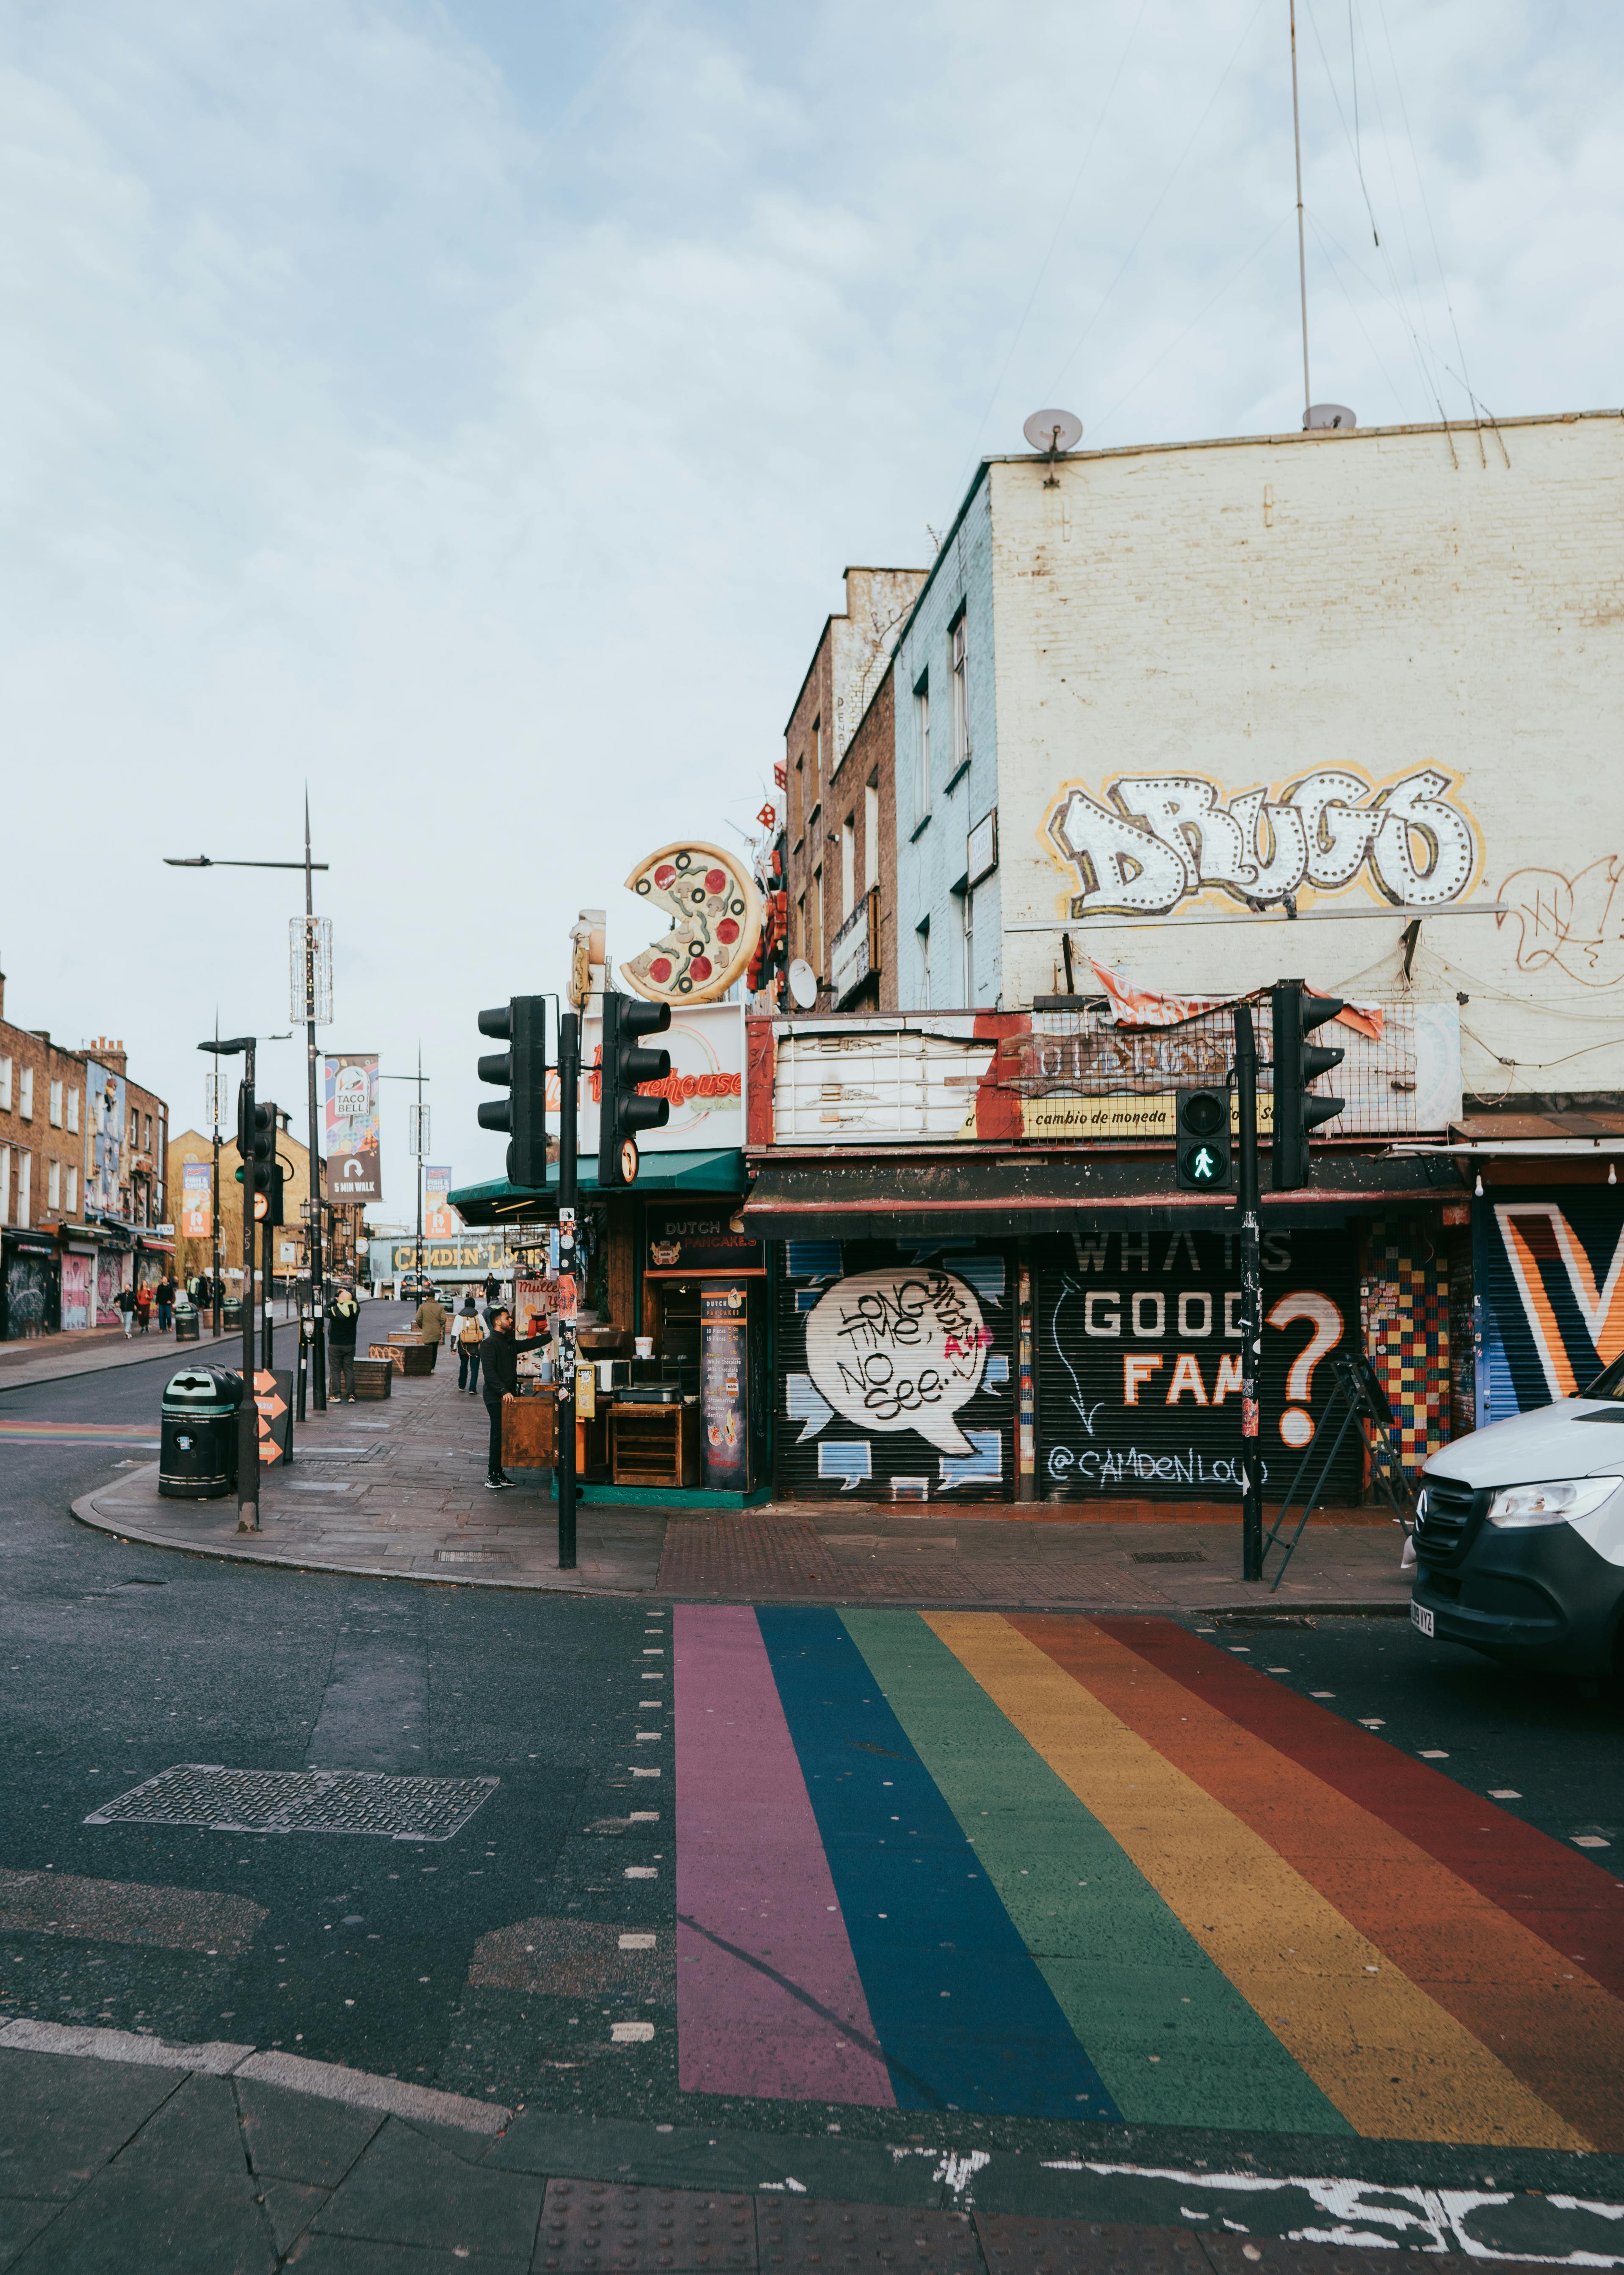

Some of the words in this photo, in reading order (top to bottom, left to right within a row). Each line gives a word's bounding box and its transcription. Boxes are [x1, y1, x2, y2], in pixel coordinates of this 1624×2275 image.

[1048, 769, 1474, 918] DRUGS
[337, 1095, 364, 1103] TACO
[1036, 1111, 1087, 1125] cambio
[1091, 1110, 1108, 1124] de
[1112, 1110, 1166, 1122] moneda
[334, 1183, 339, 1192] 5
[340, 1182, 354, 1192] MIN
[355, 1182, 375, 1192] WALK
[665, 1221, 720, 1234] DUTCH
[684, 1236, 757, 1247] PANCAKES
[518, 1281, 559, 1293] Mulle
[840, 1281, 930, 1324] LONG
[837, 1353, 894, 1394] NO
